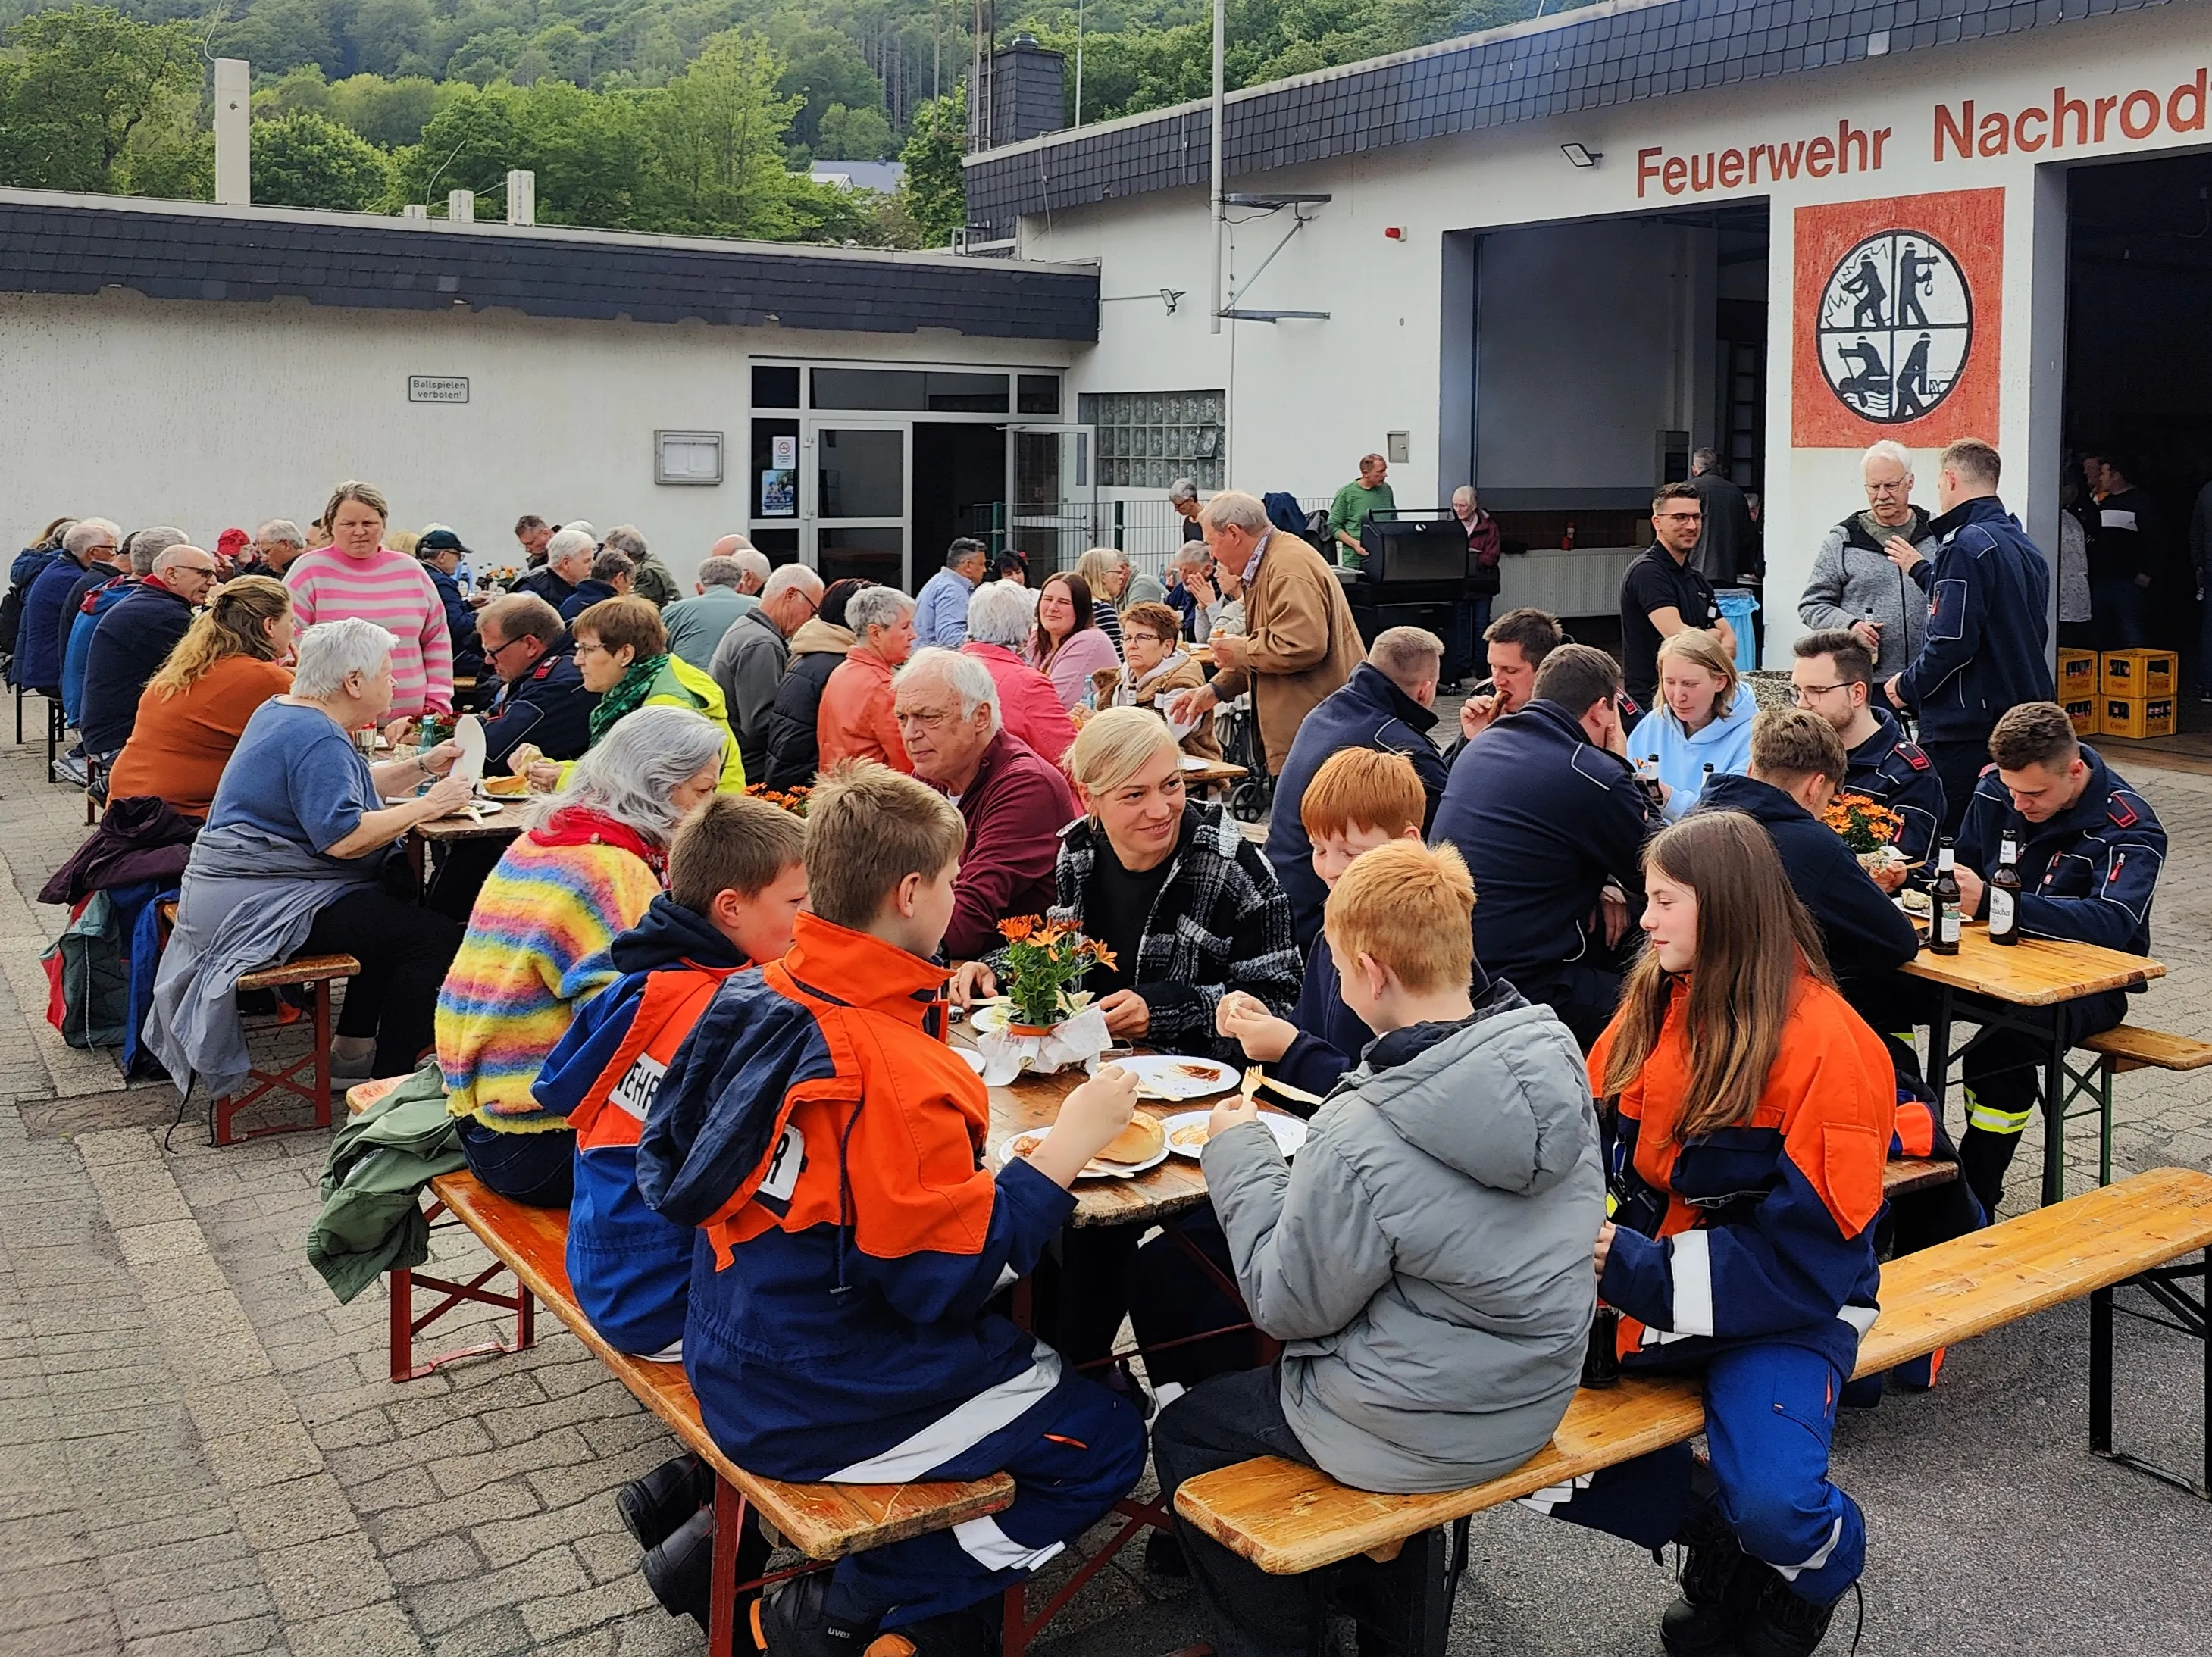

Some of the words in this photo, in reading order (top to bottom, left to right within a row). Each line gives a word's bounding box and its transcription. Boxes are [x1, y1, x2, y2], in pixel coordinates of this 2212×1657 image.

[1636, 120, 1891, 199] Feuerwehr
[1934, 67, 2212, 162] Nachrod
[413, 380, 465, 389] Ballspielen
[828, 1627, 851, 1639] uvex
